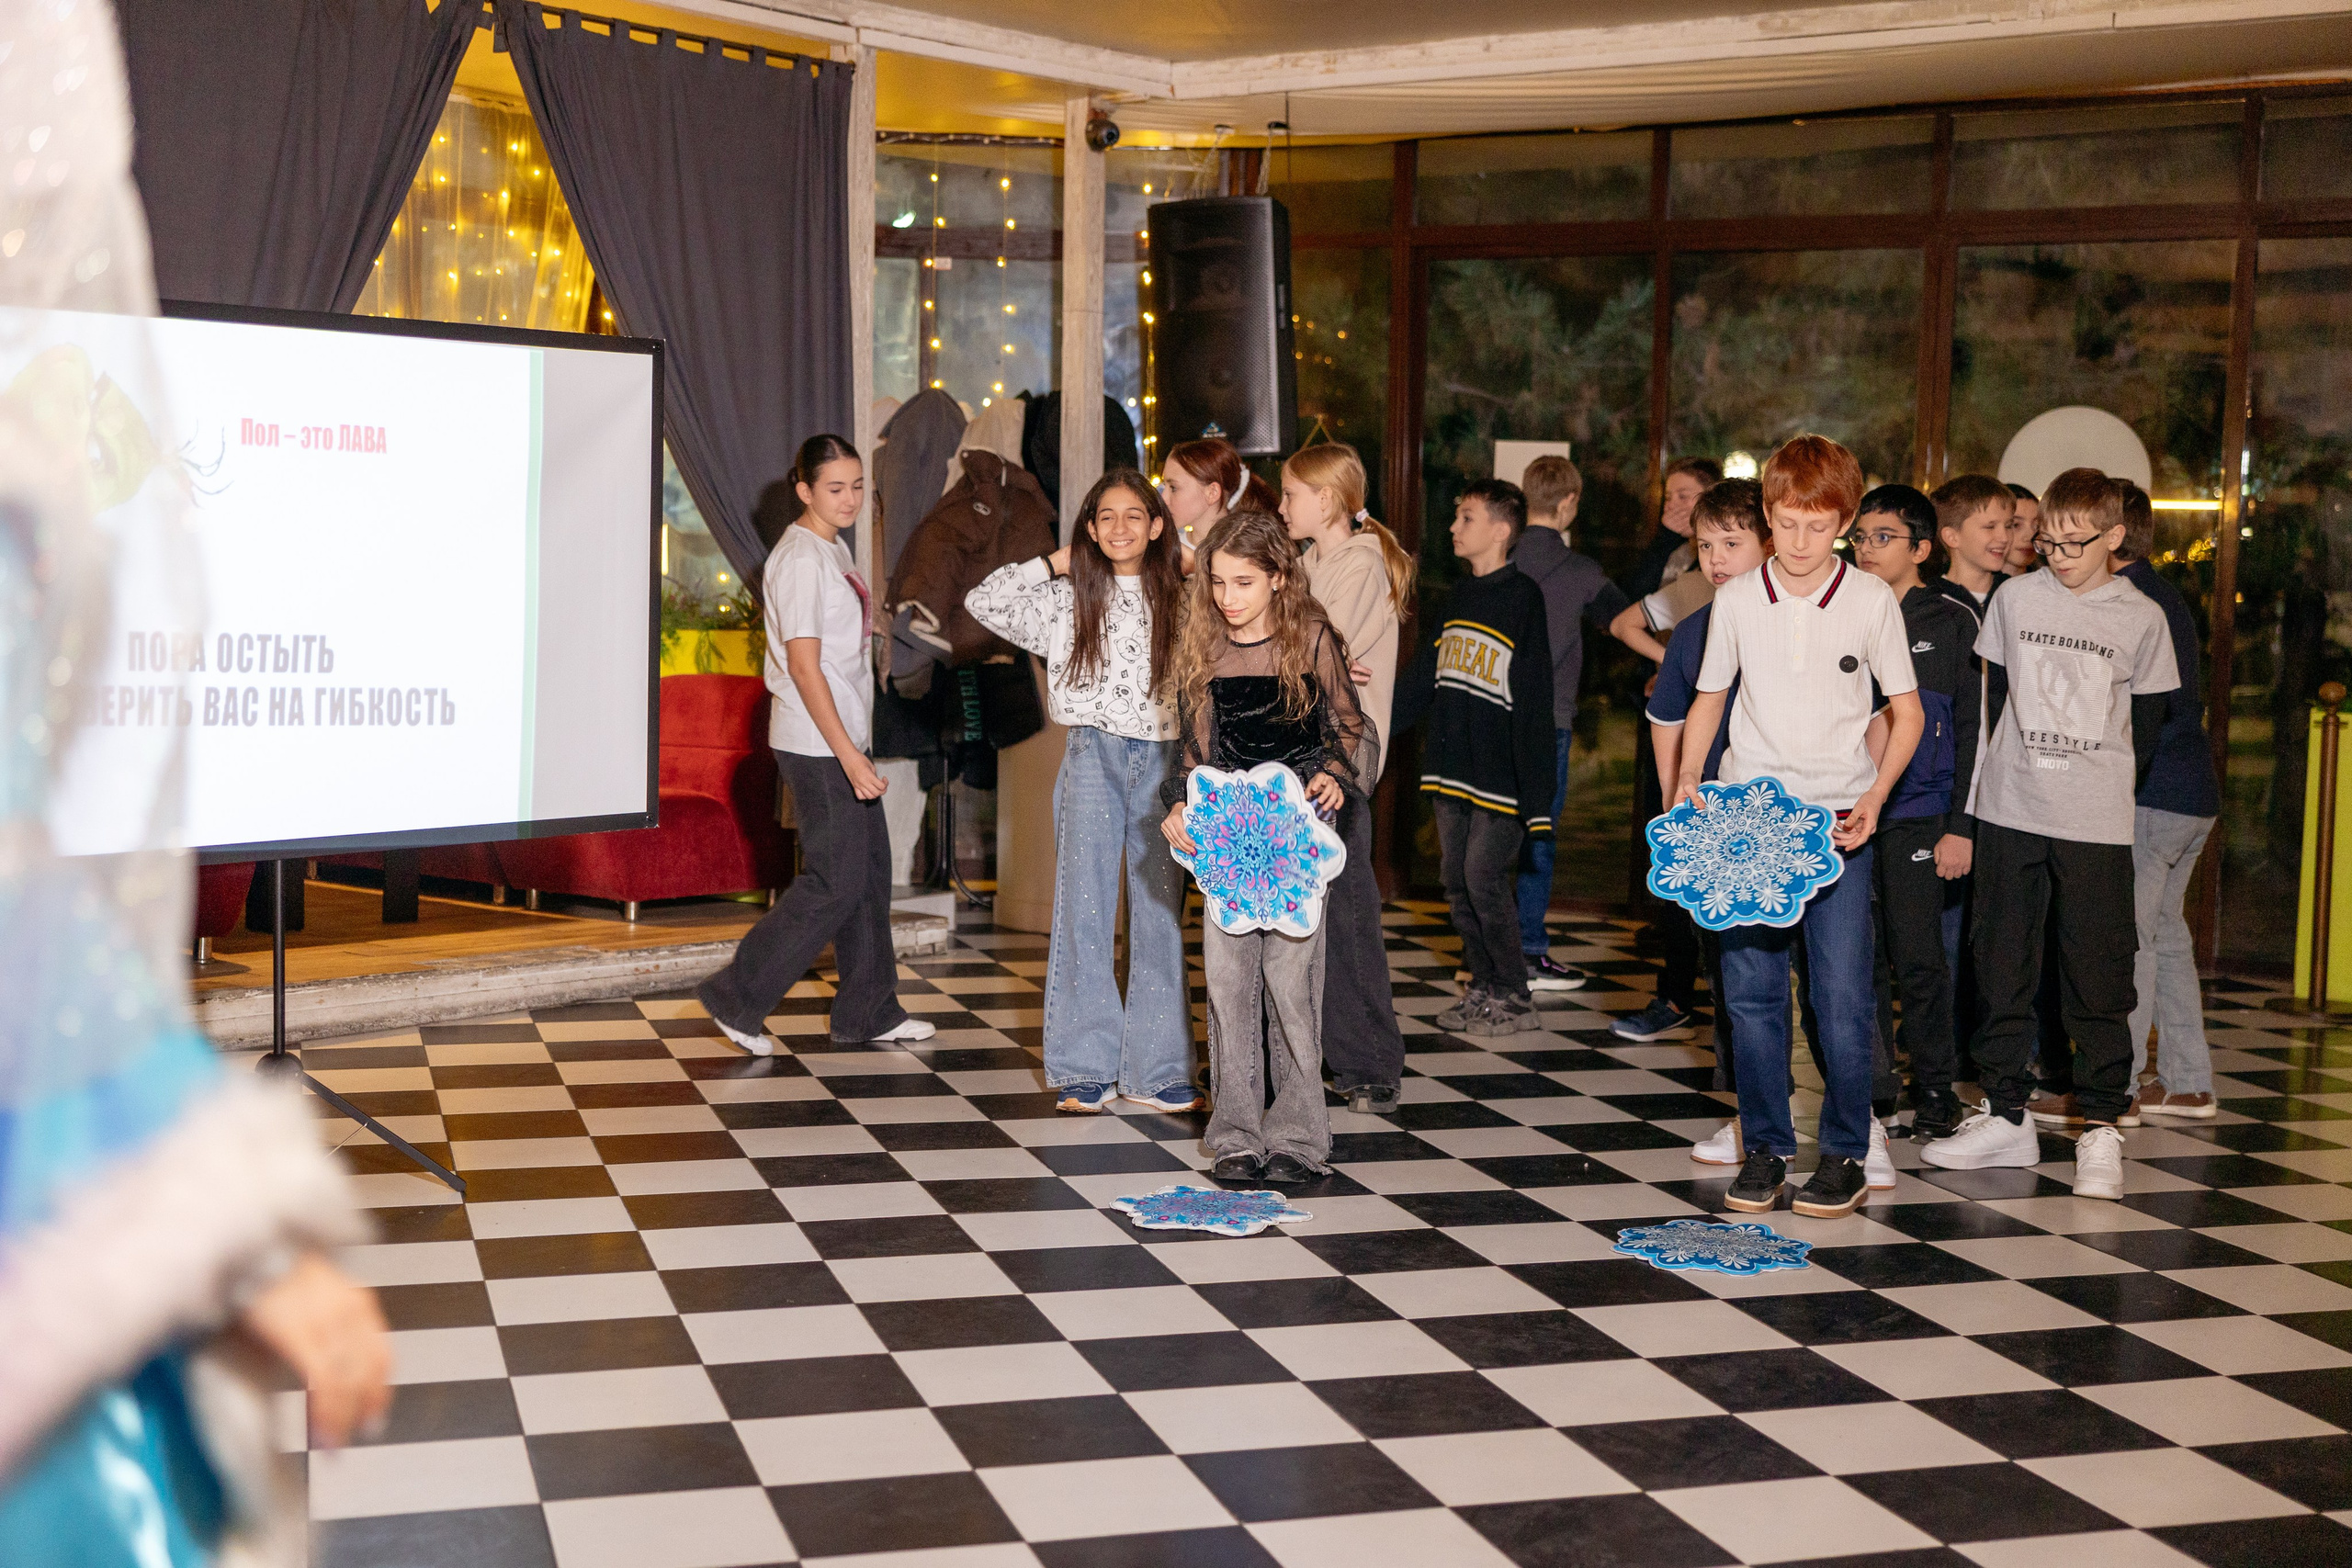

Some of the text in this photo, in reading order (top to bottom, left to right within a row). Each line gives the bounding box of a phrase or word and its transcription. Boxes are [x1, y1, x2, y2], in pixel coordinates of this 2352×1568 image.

[241, 417, 279, 447] Пол
[300, 425, 334, 451] это
[338, 423, 388, 454] ЛАВА
[128, 630, 334, 674] ПОРА ОСТЫТЬ
[91, 685, 456, 727] ЕРИТЬ ВАС НА ГИБКОСТЬ
[963, 699, 982, 741] LOVE
[2036, 758, 2069, 771] INOVO
